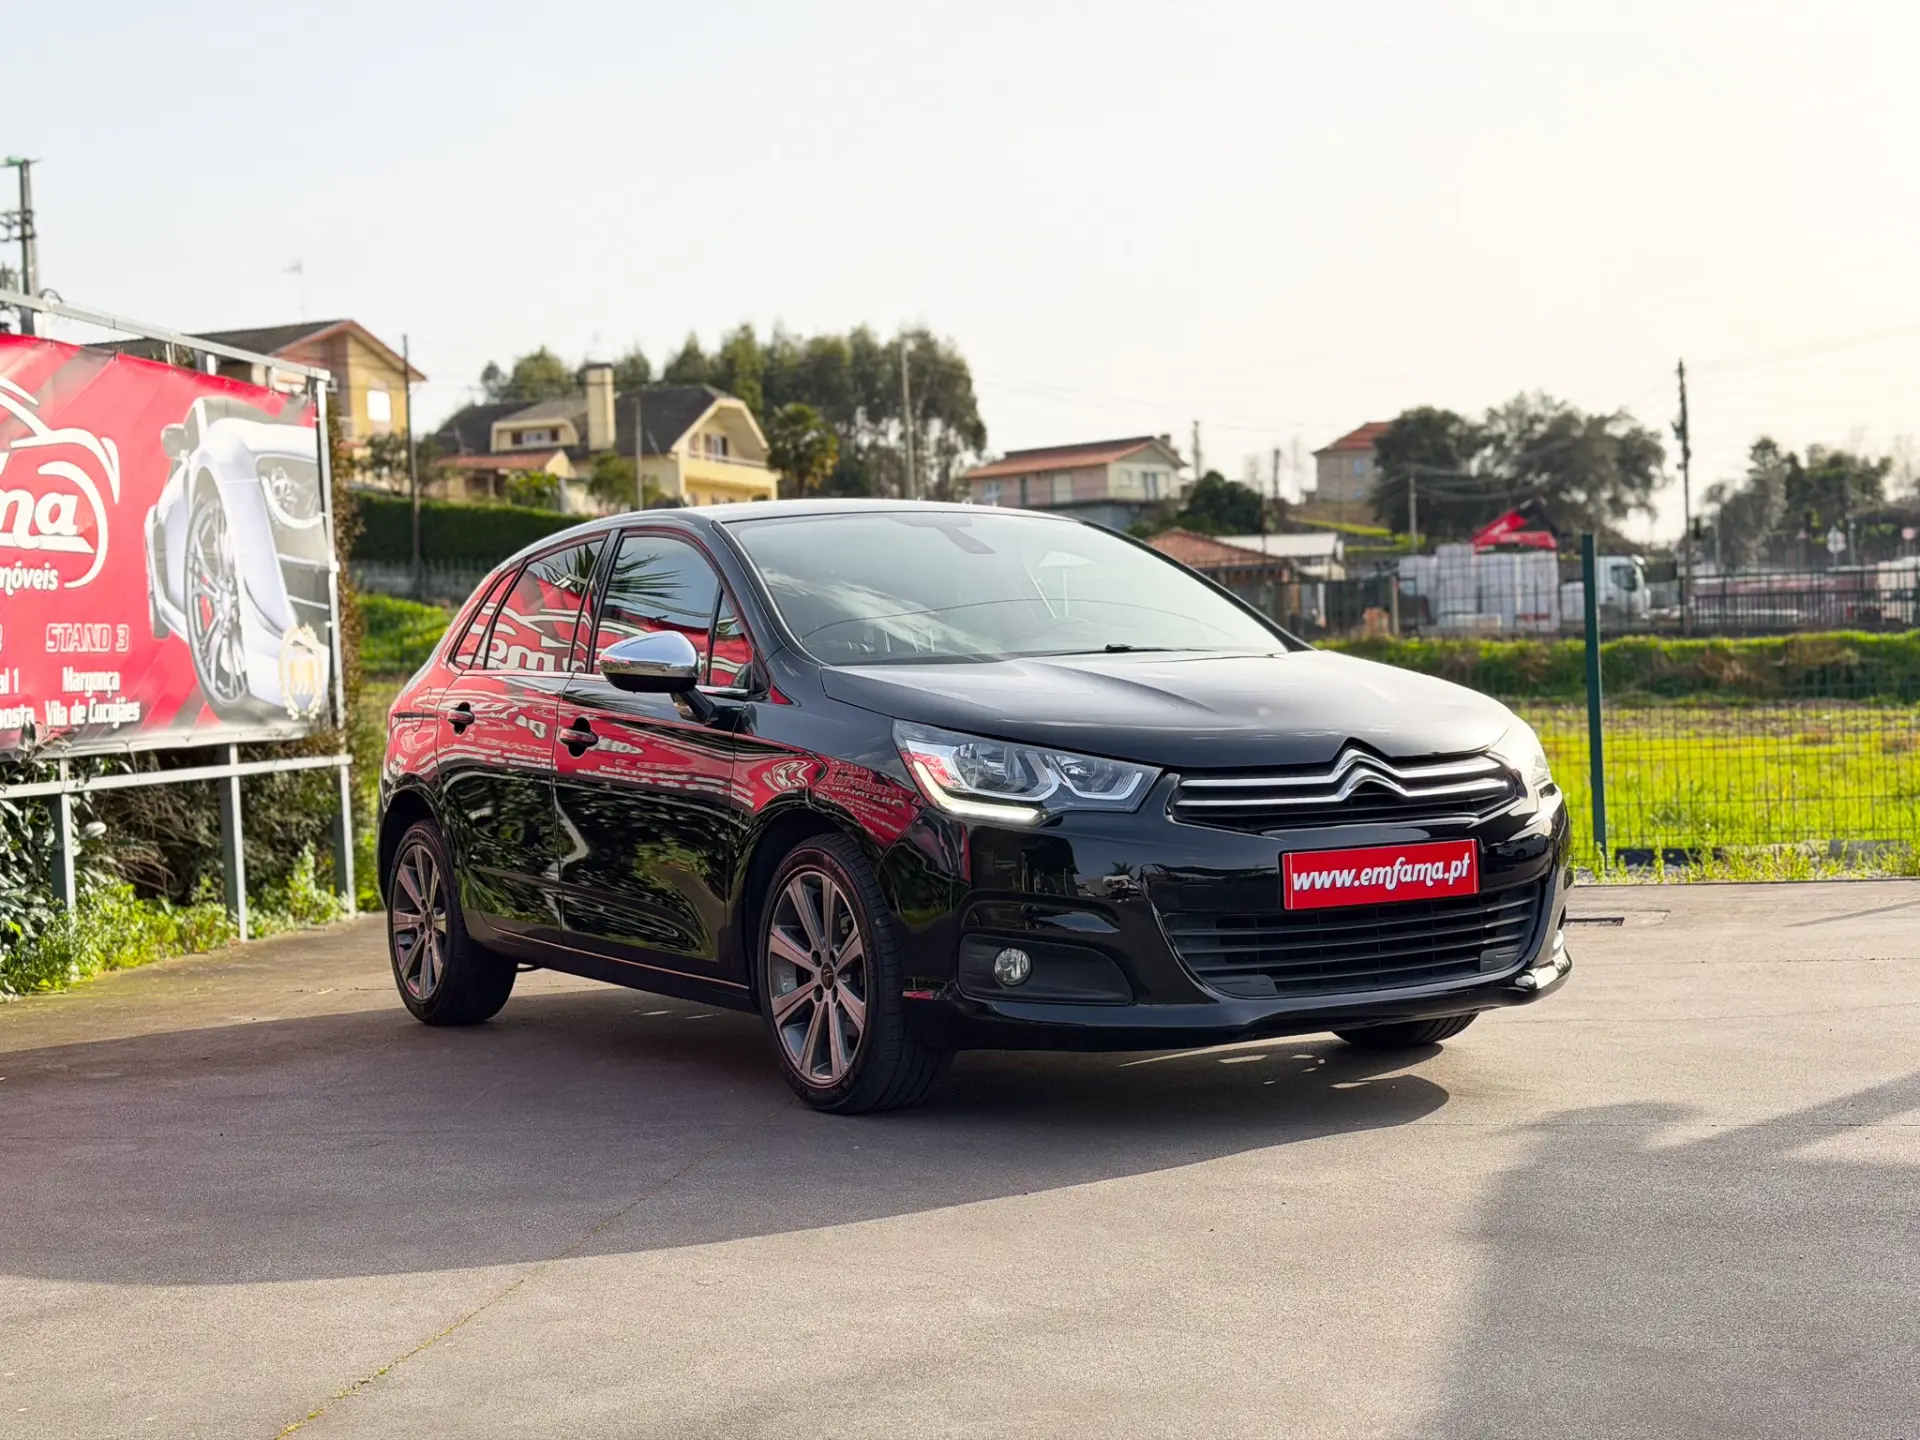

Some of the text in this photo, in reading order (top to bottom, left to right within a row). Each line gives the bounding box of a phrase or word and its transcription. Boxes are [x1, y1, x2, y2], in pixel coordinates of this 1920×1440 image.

[45, 623, 129, 652] STAND 3
[45, 700, 68, 726] Vila
[70, 699, 86, 725] de
[1292, 852, 1471, 891] www.emfama.pt
